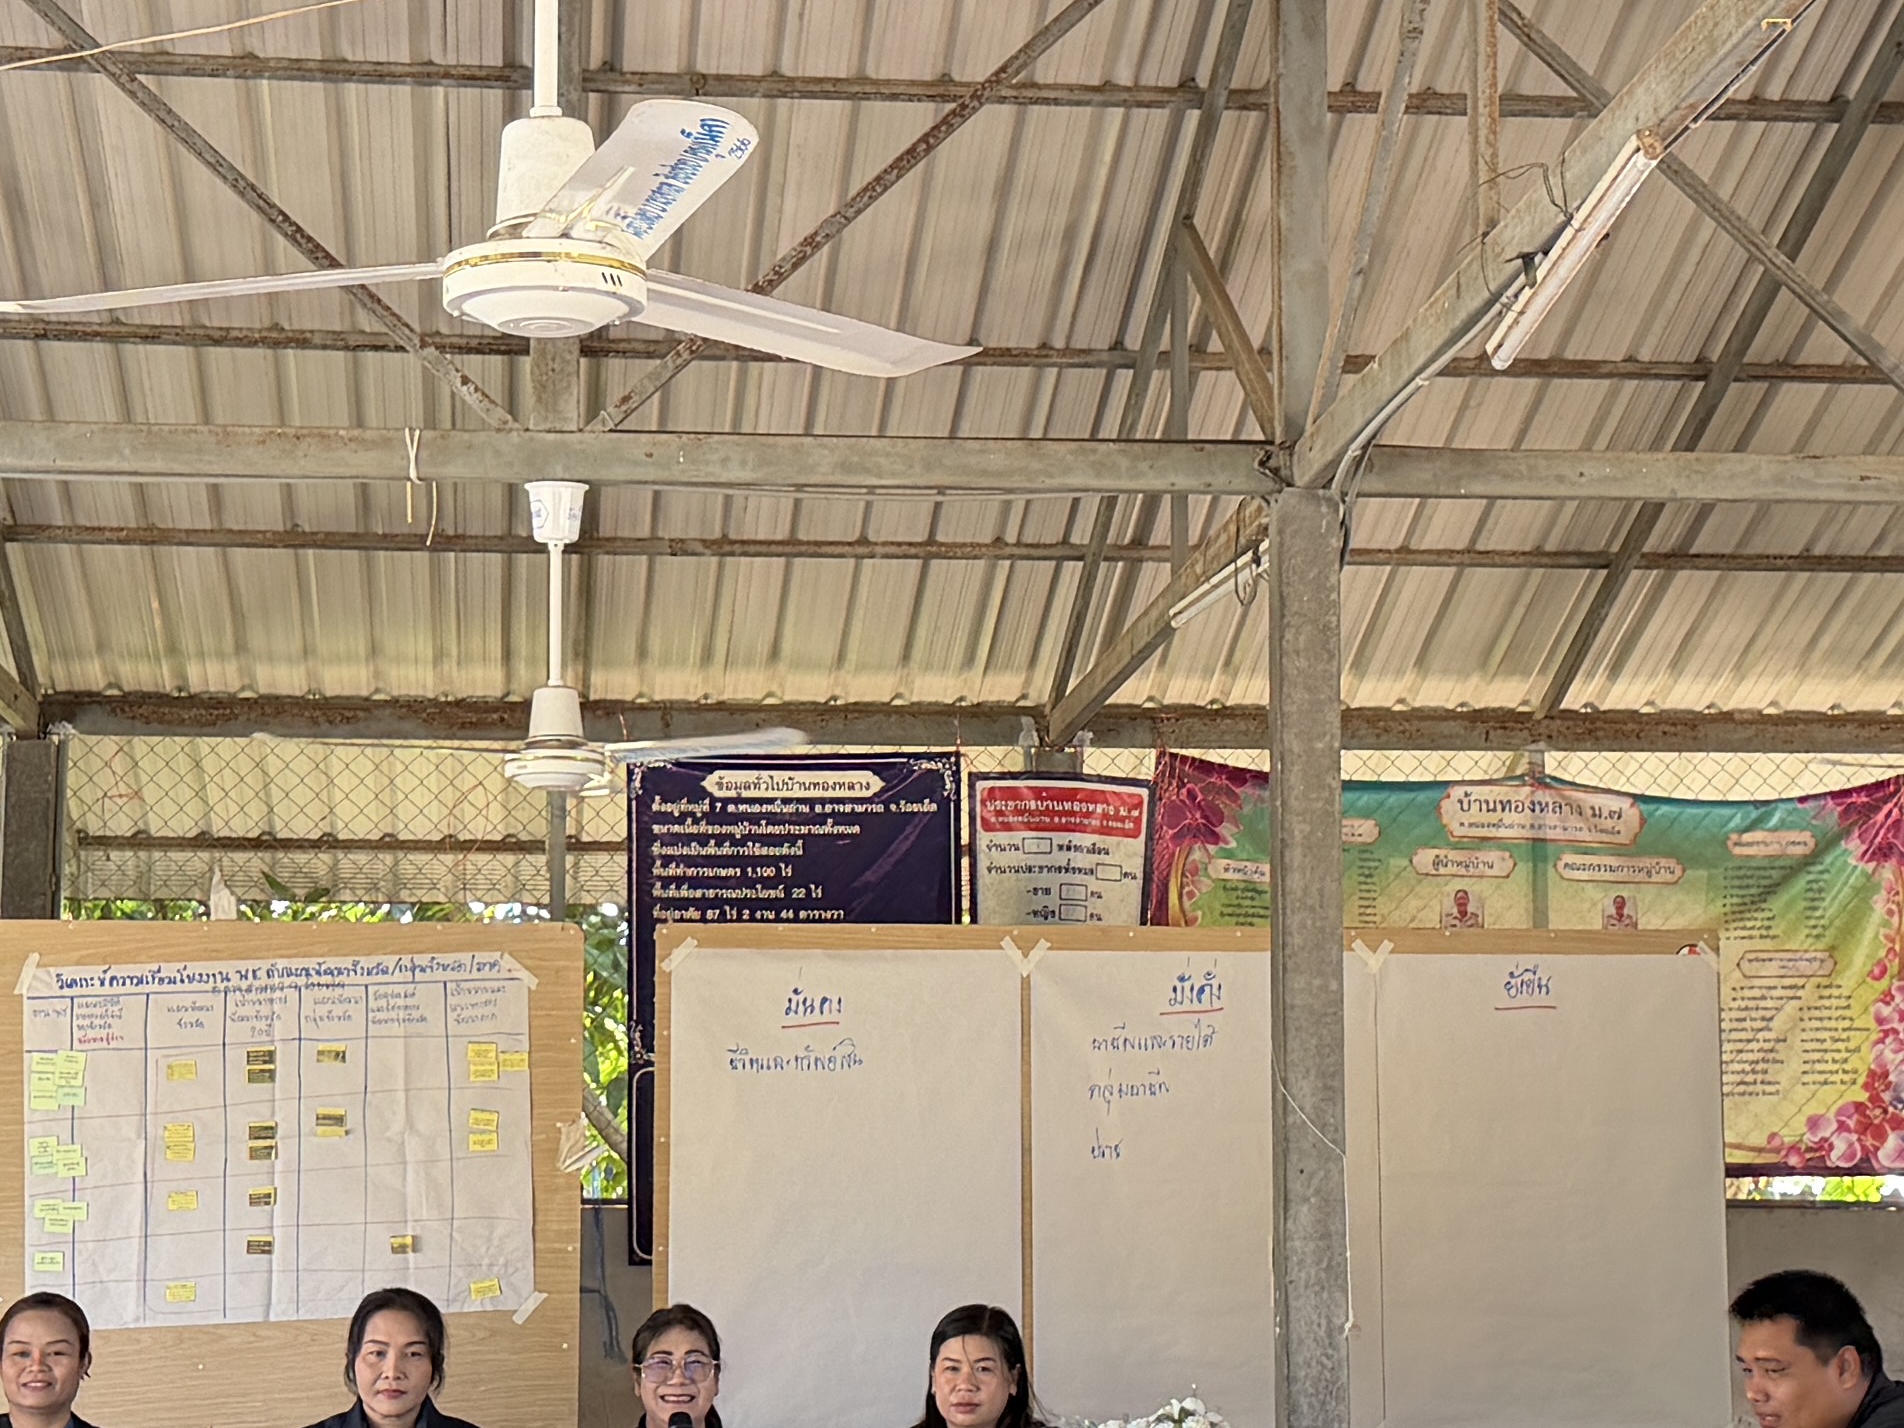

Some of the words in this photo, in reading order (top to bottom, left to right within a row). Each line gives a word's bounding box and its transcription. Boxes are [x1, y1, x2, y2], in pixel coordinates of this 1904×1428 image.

[714, 774, 871, 797] ข้อมูลทั่วไปบ้านทองหลาง
[1456, 790, 1584, 819] บ้านทองหลาง
[791, 887, 806, 899] 22
